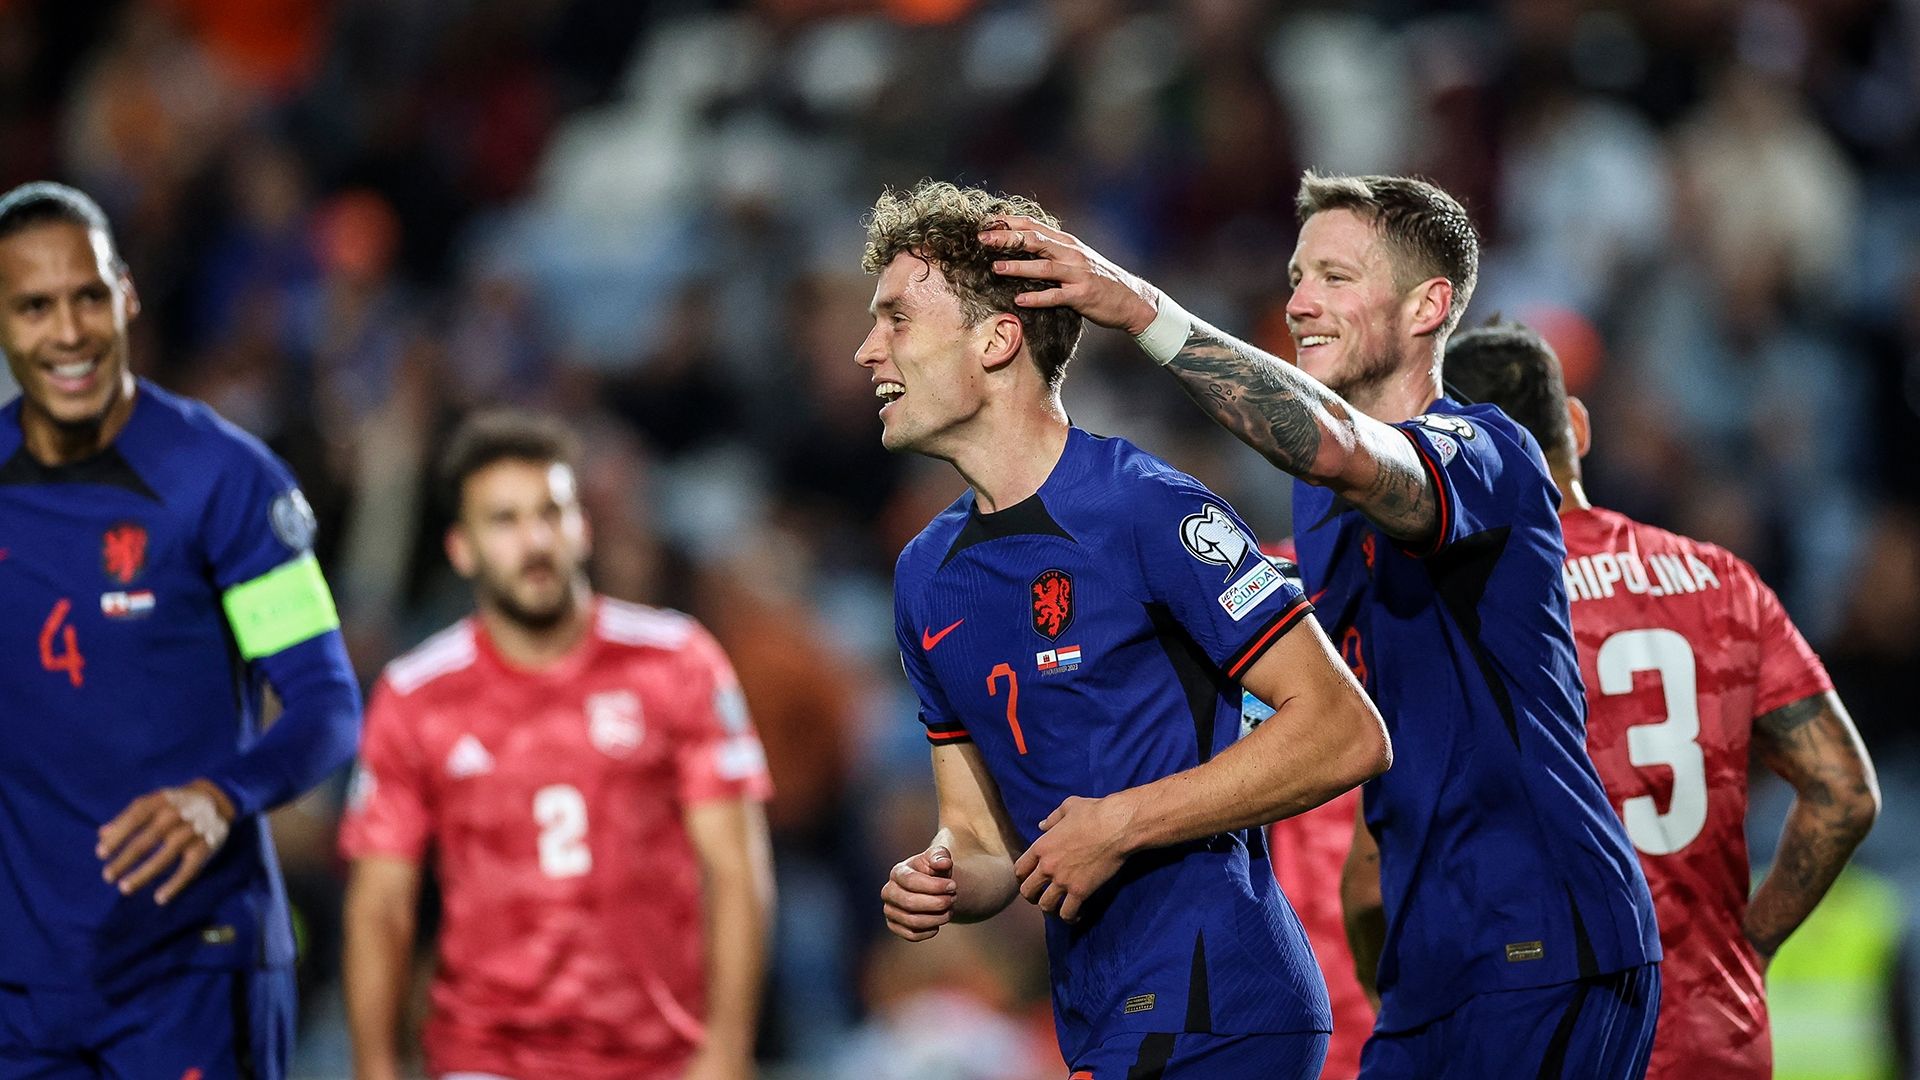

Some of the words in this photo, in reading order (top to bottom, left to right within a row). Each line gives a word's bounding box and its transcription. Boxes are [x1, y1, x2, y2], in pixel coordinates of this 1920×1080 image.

[1221, 587, 1239, 603] UEFA
[38, 598, 86, 688] 4
[986, 662, 1028, 755] 7
[1597, 628, 1708, 856] 3
[532, 784, 592, 880] 2
